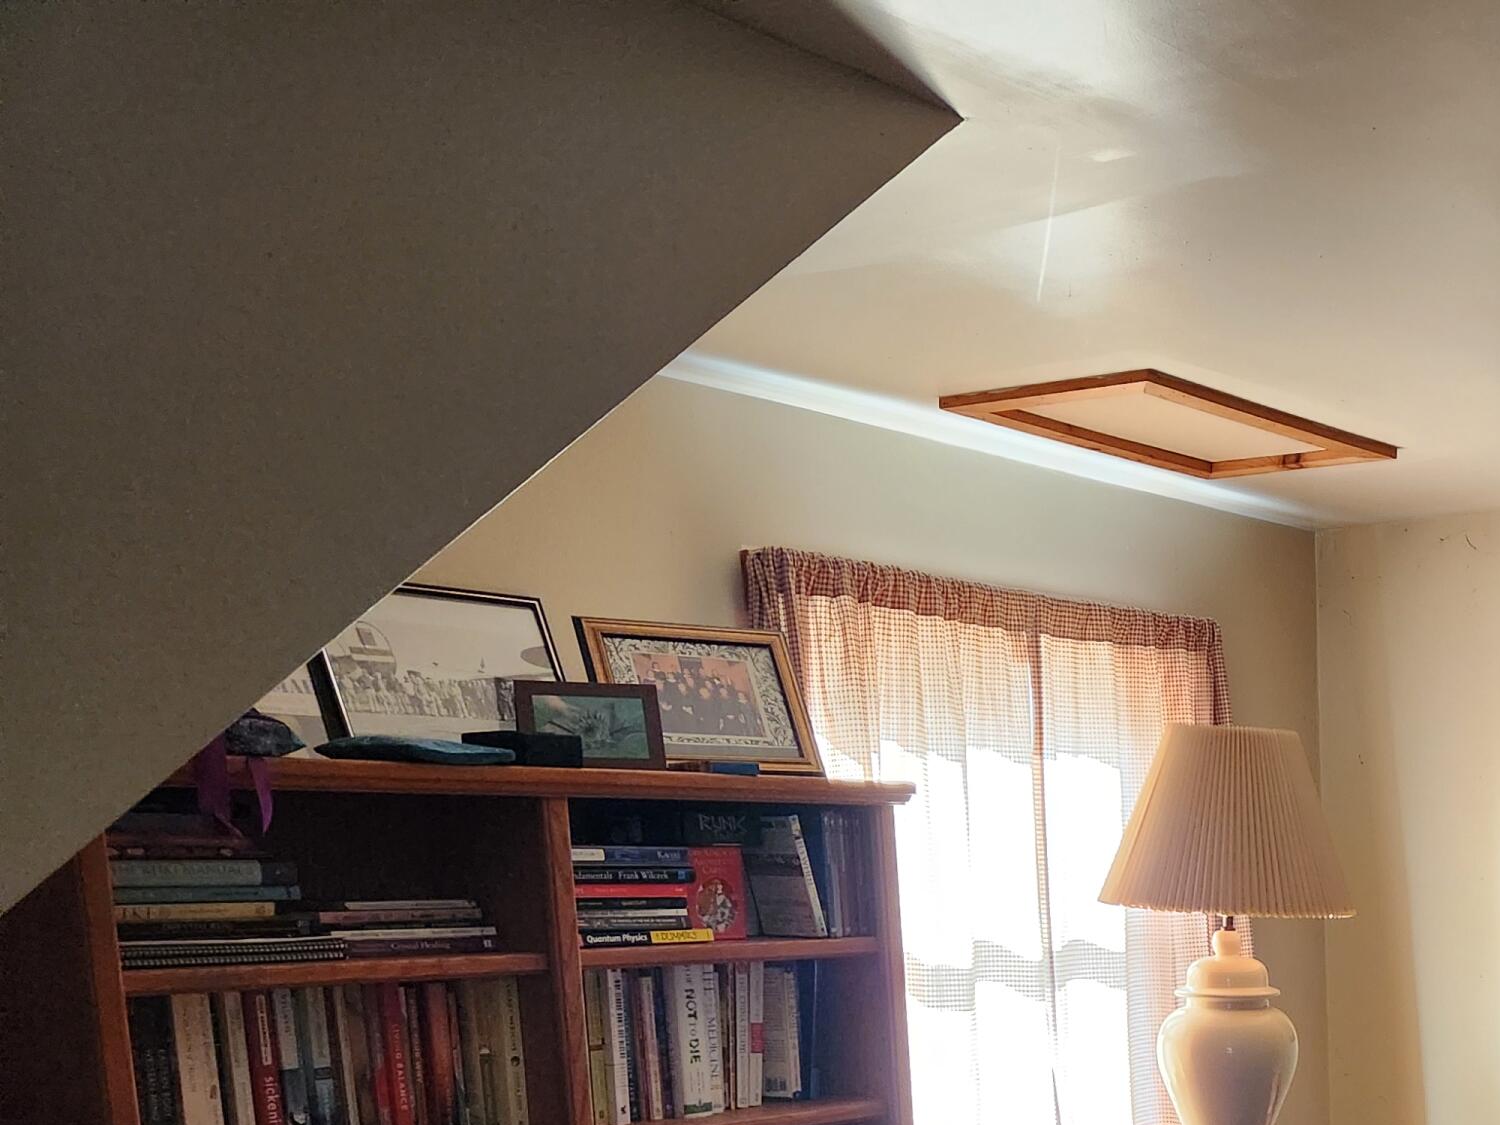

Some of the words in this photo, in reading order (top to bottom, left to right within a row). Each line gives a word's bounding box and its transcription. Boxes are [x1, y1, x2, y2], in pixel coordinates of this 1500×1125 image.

[618, 872, 639, 880] Frank
[586, 934, 621, 944] Quantum
[622, 934, 648, 942] Physics
[684, 988, 697, 1020] NOT
[390, 1023, 402, 1059] LIVING
[688, 1038, 701, 1064] DIE
[705, 1017, 720, 1079] MEDICINE
[394, 1062, 409, 1111] BALANCE
